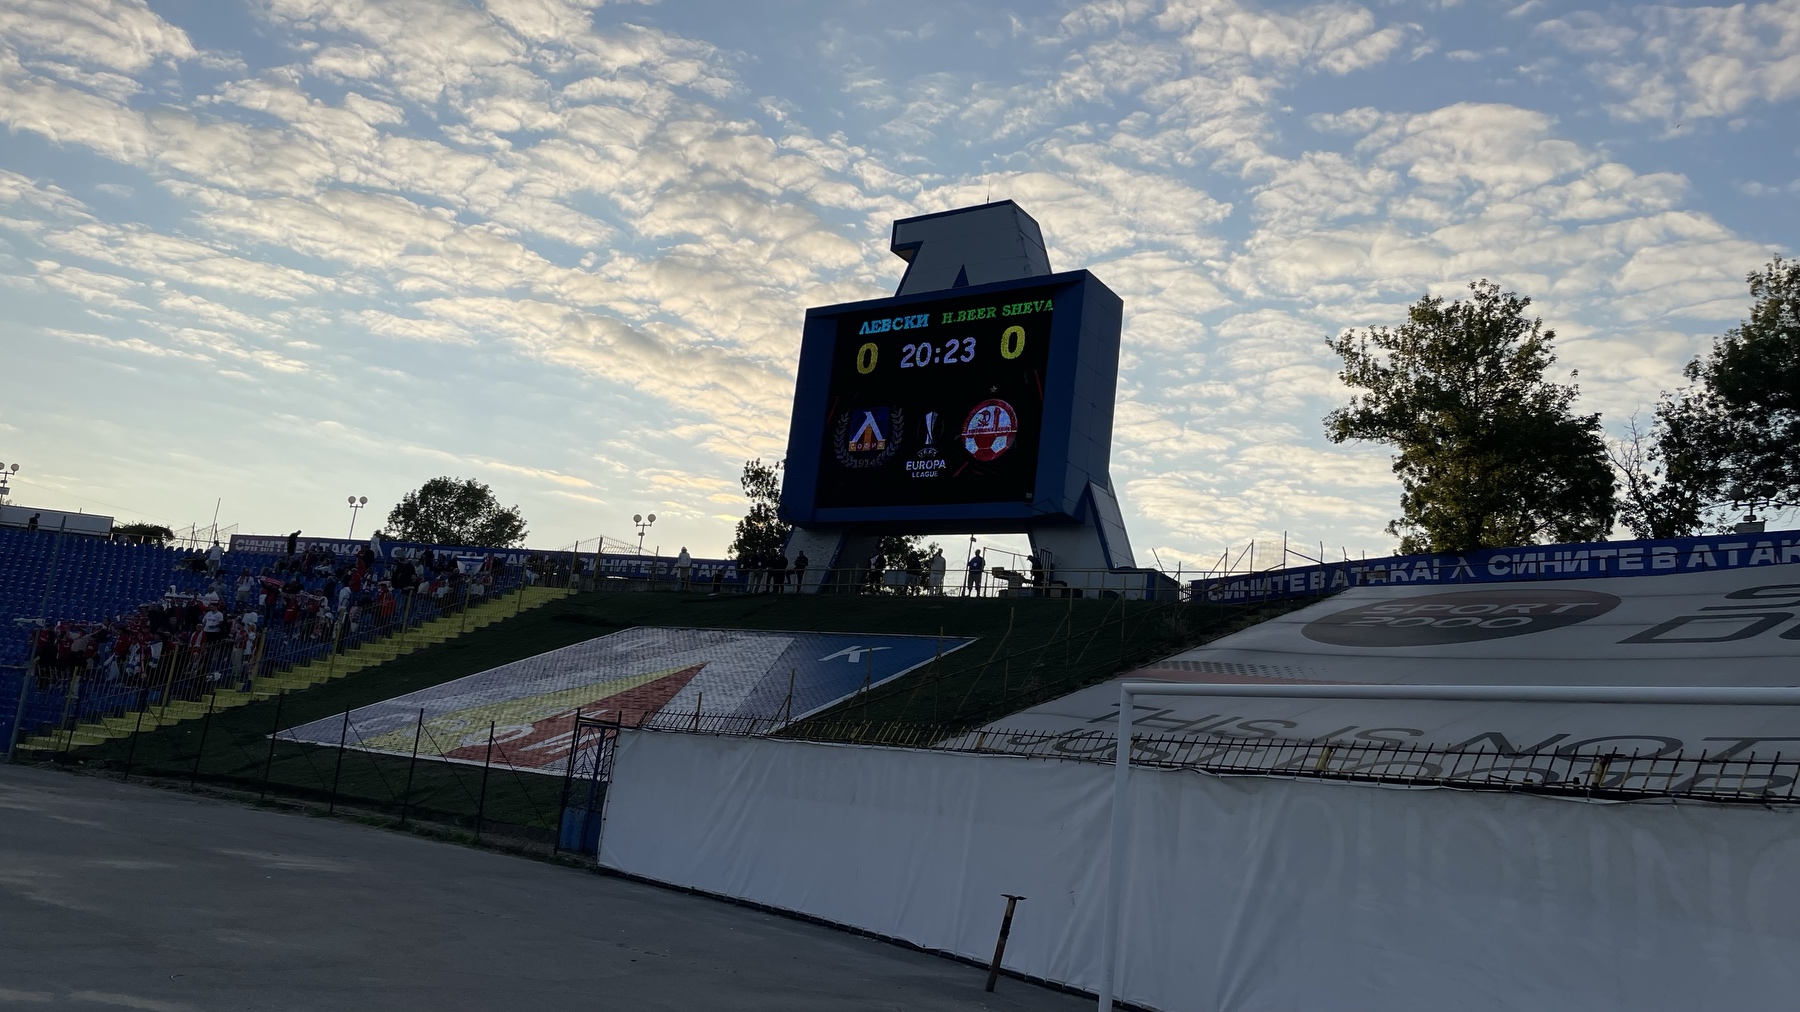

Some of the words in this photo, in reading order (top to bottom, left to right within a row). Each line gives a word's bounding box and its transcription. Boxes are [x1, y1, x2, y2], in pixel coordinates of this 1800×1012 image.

[941, 306, 998, 324] H.BEER
[1002, 299, 1054, 316] SHEVA
[900, 336, 977, 369] 20:23
[1000, 325, 1026, 360] 0
[856, 342, 879, 375] 0
[905, 459, 947, 471] EUROPA
[911, 470, 939, 478] LEAGUE
[1487, 547, 1645, 576] СИНИТЕ
[1348, 616, 1533, 628] 2000
[1361, 602, 1600, 615] SPORT
[1086, 703, 1298, 741] THIS
[1303, 725, 1425, 748] IS
[1436, 731, 1800, 766] NOT
